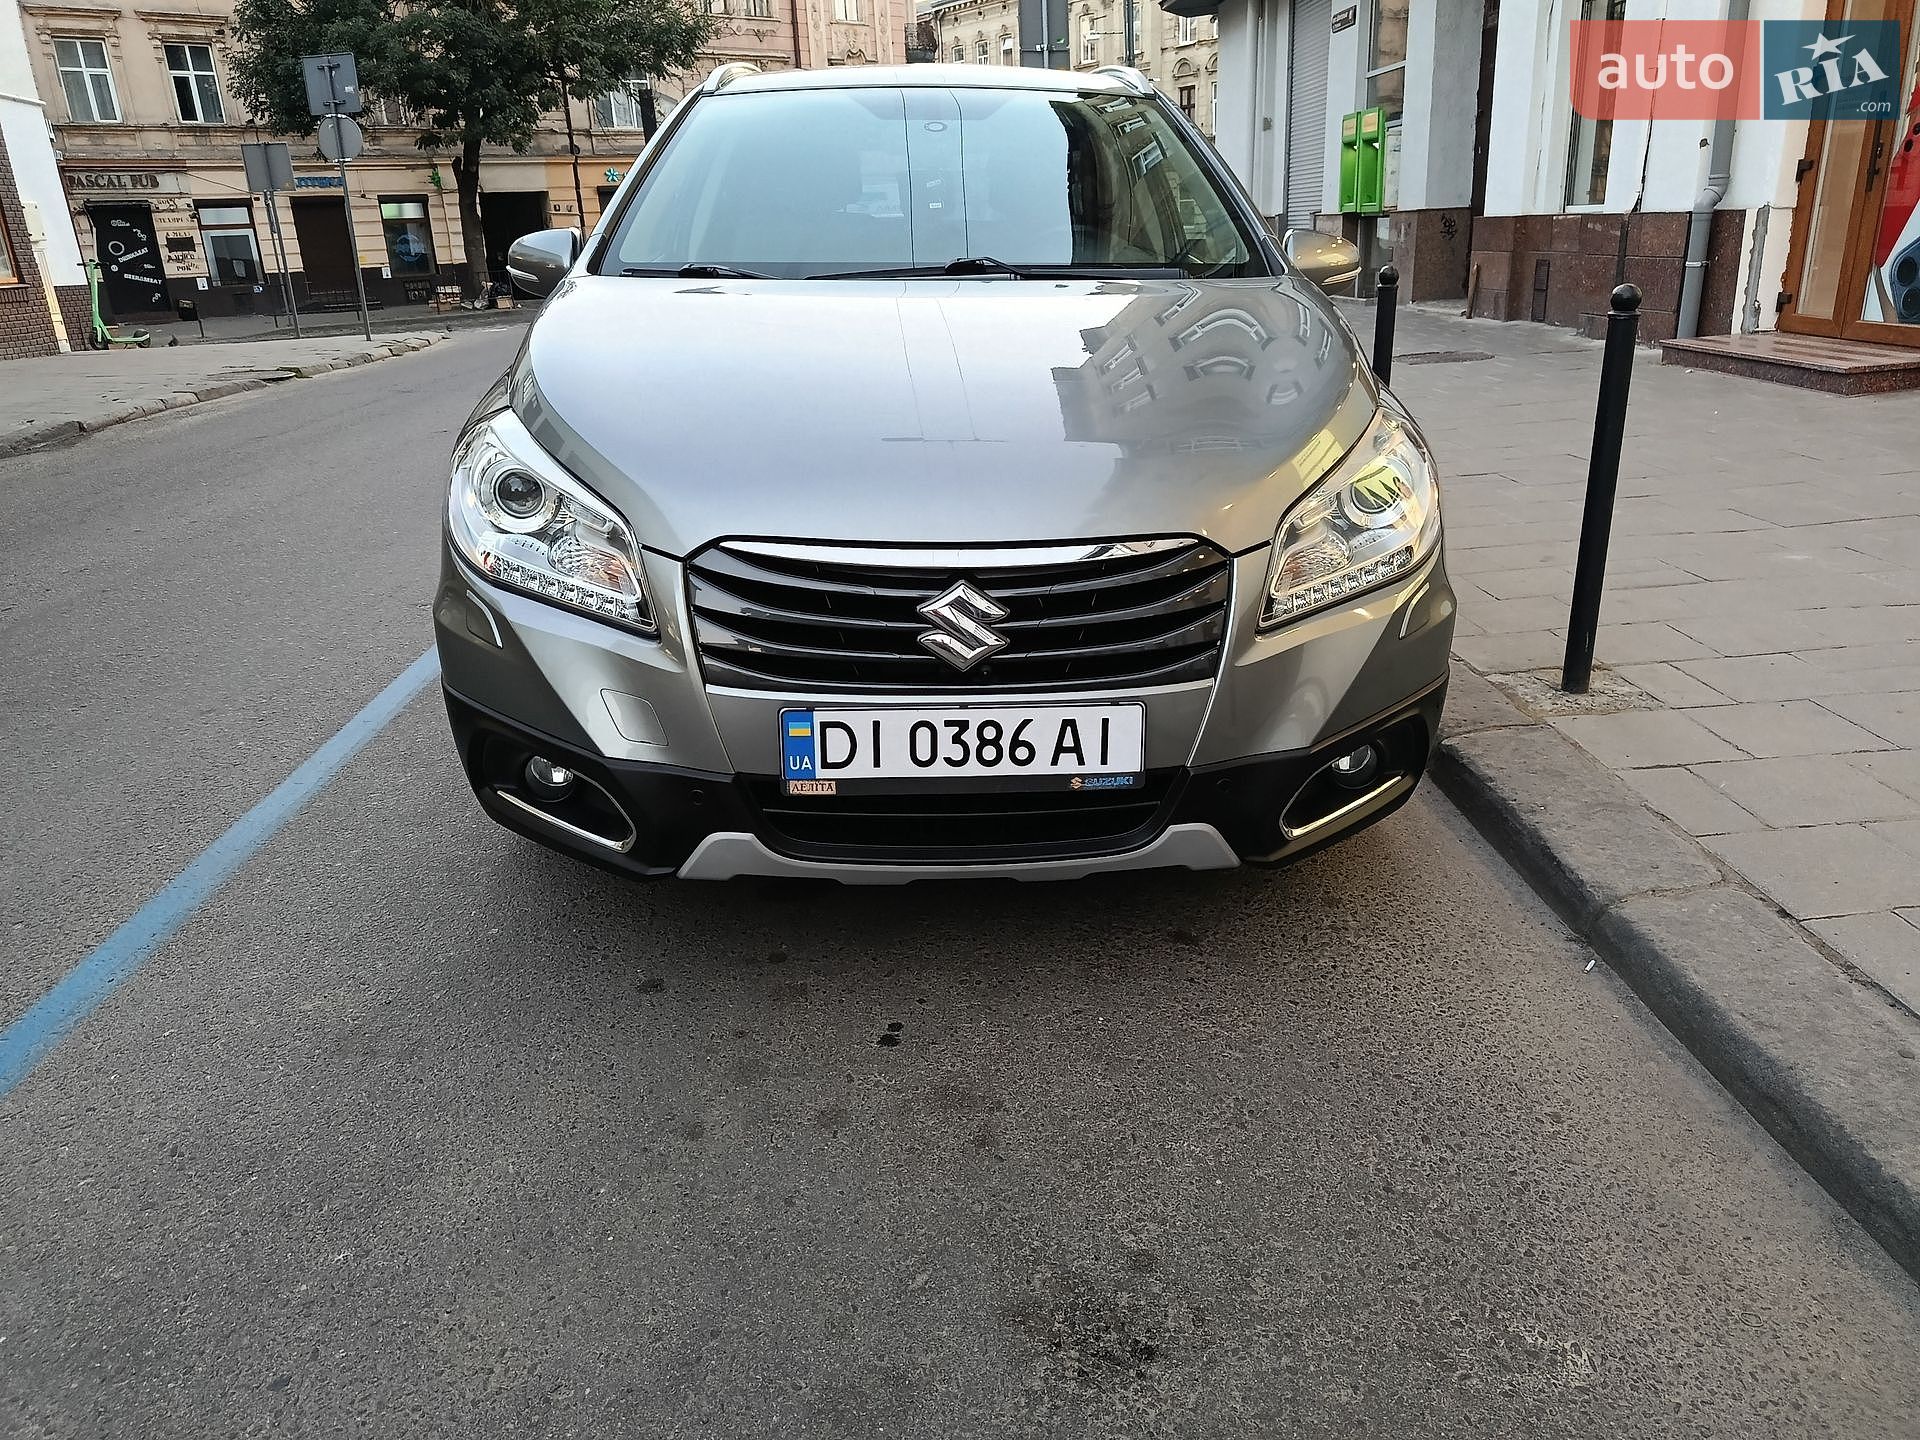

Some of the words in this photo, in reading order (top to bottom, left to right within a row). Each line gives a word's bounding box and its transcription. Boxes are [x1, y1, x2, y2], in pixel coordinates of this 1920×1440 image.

[65, 174, 127, 188] PASCAL
[130, 174, 159, 188] PUB
[819, 720, 881, 770] DI
[909, 719, 1036, 768] 0386
[1050, 717, 1110, 767] AI
[789, 755, 813, 770] UA
[1085, 776, 1134, 787] SUZUKI
